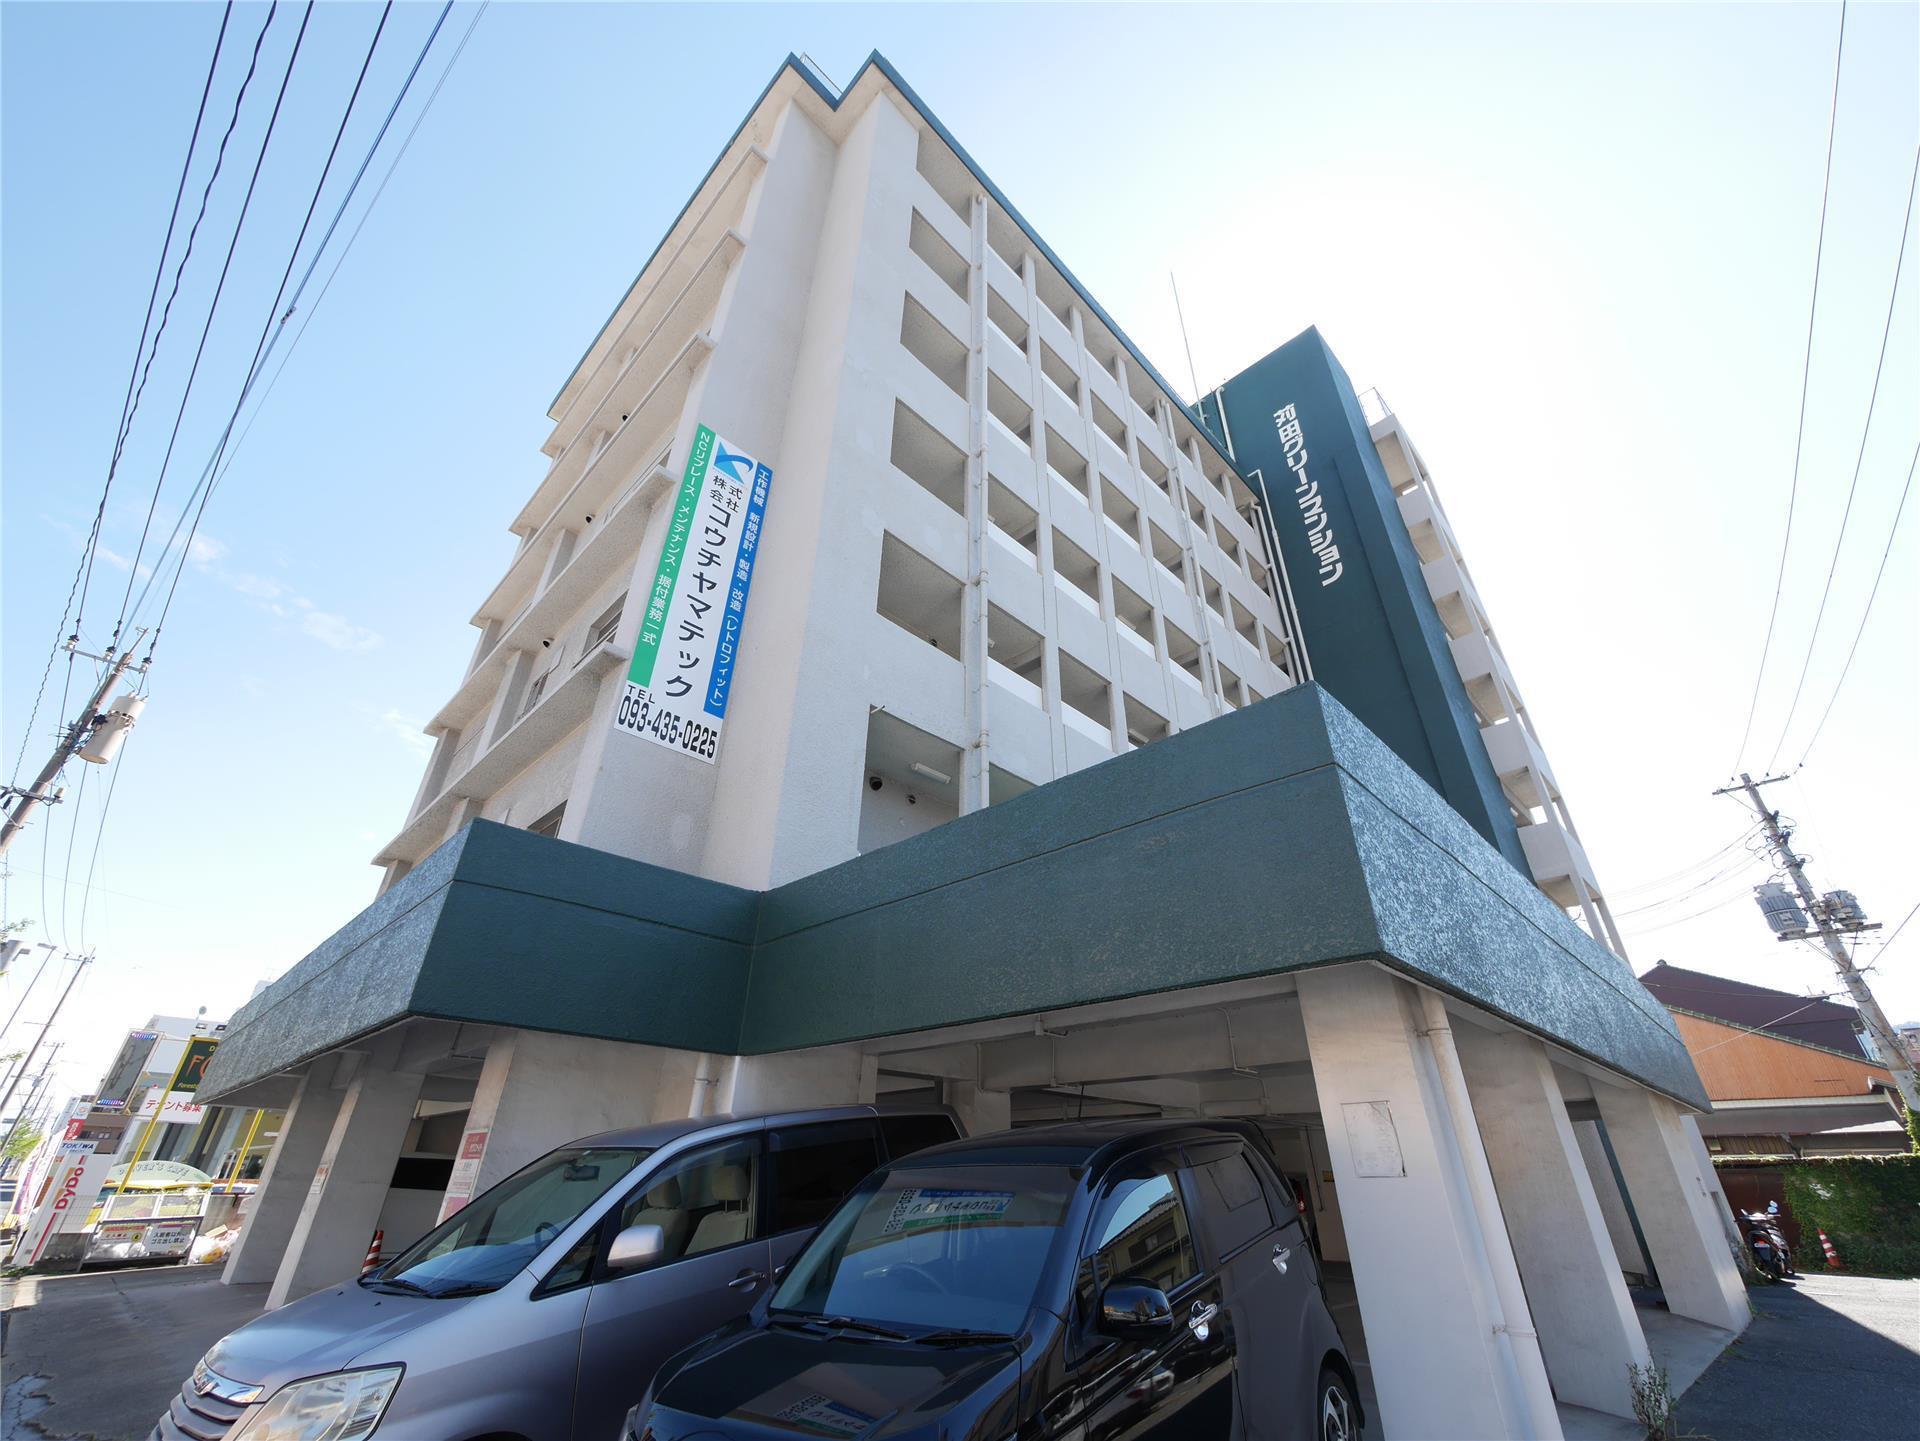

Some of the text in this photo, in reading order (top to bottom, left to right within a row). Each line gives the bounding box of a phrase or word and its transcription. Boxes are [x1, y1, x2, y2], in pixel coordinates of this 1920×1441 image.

[628, 685, 655, 704] TEL
[618, 695, 717, 758] 093-435-0225
[54, 1167, 84, 1210] DyDo
